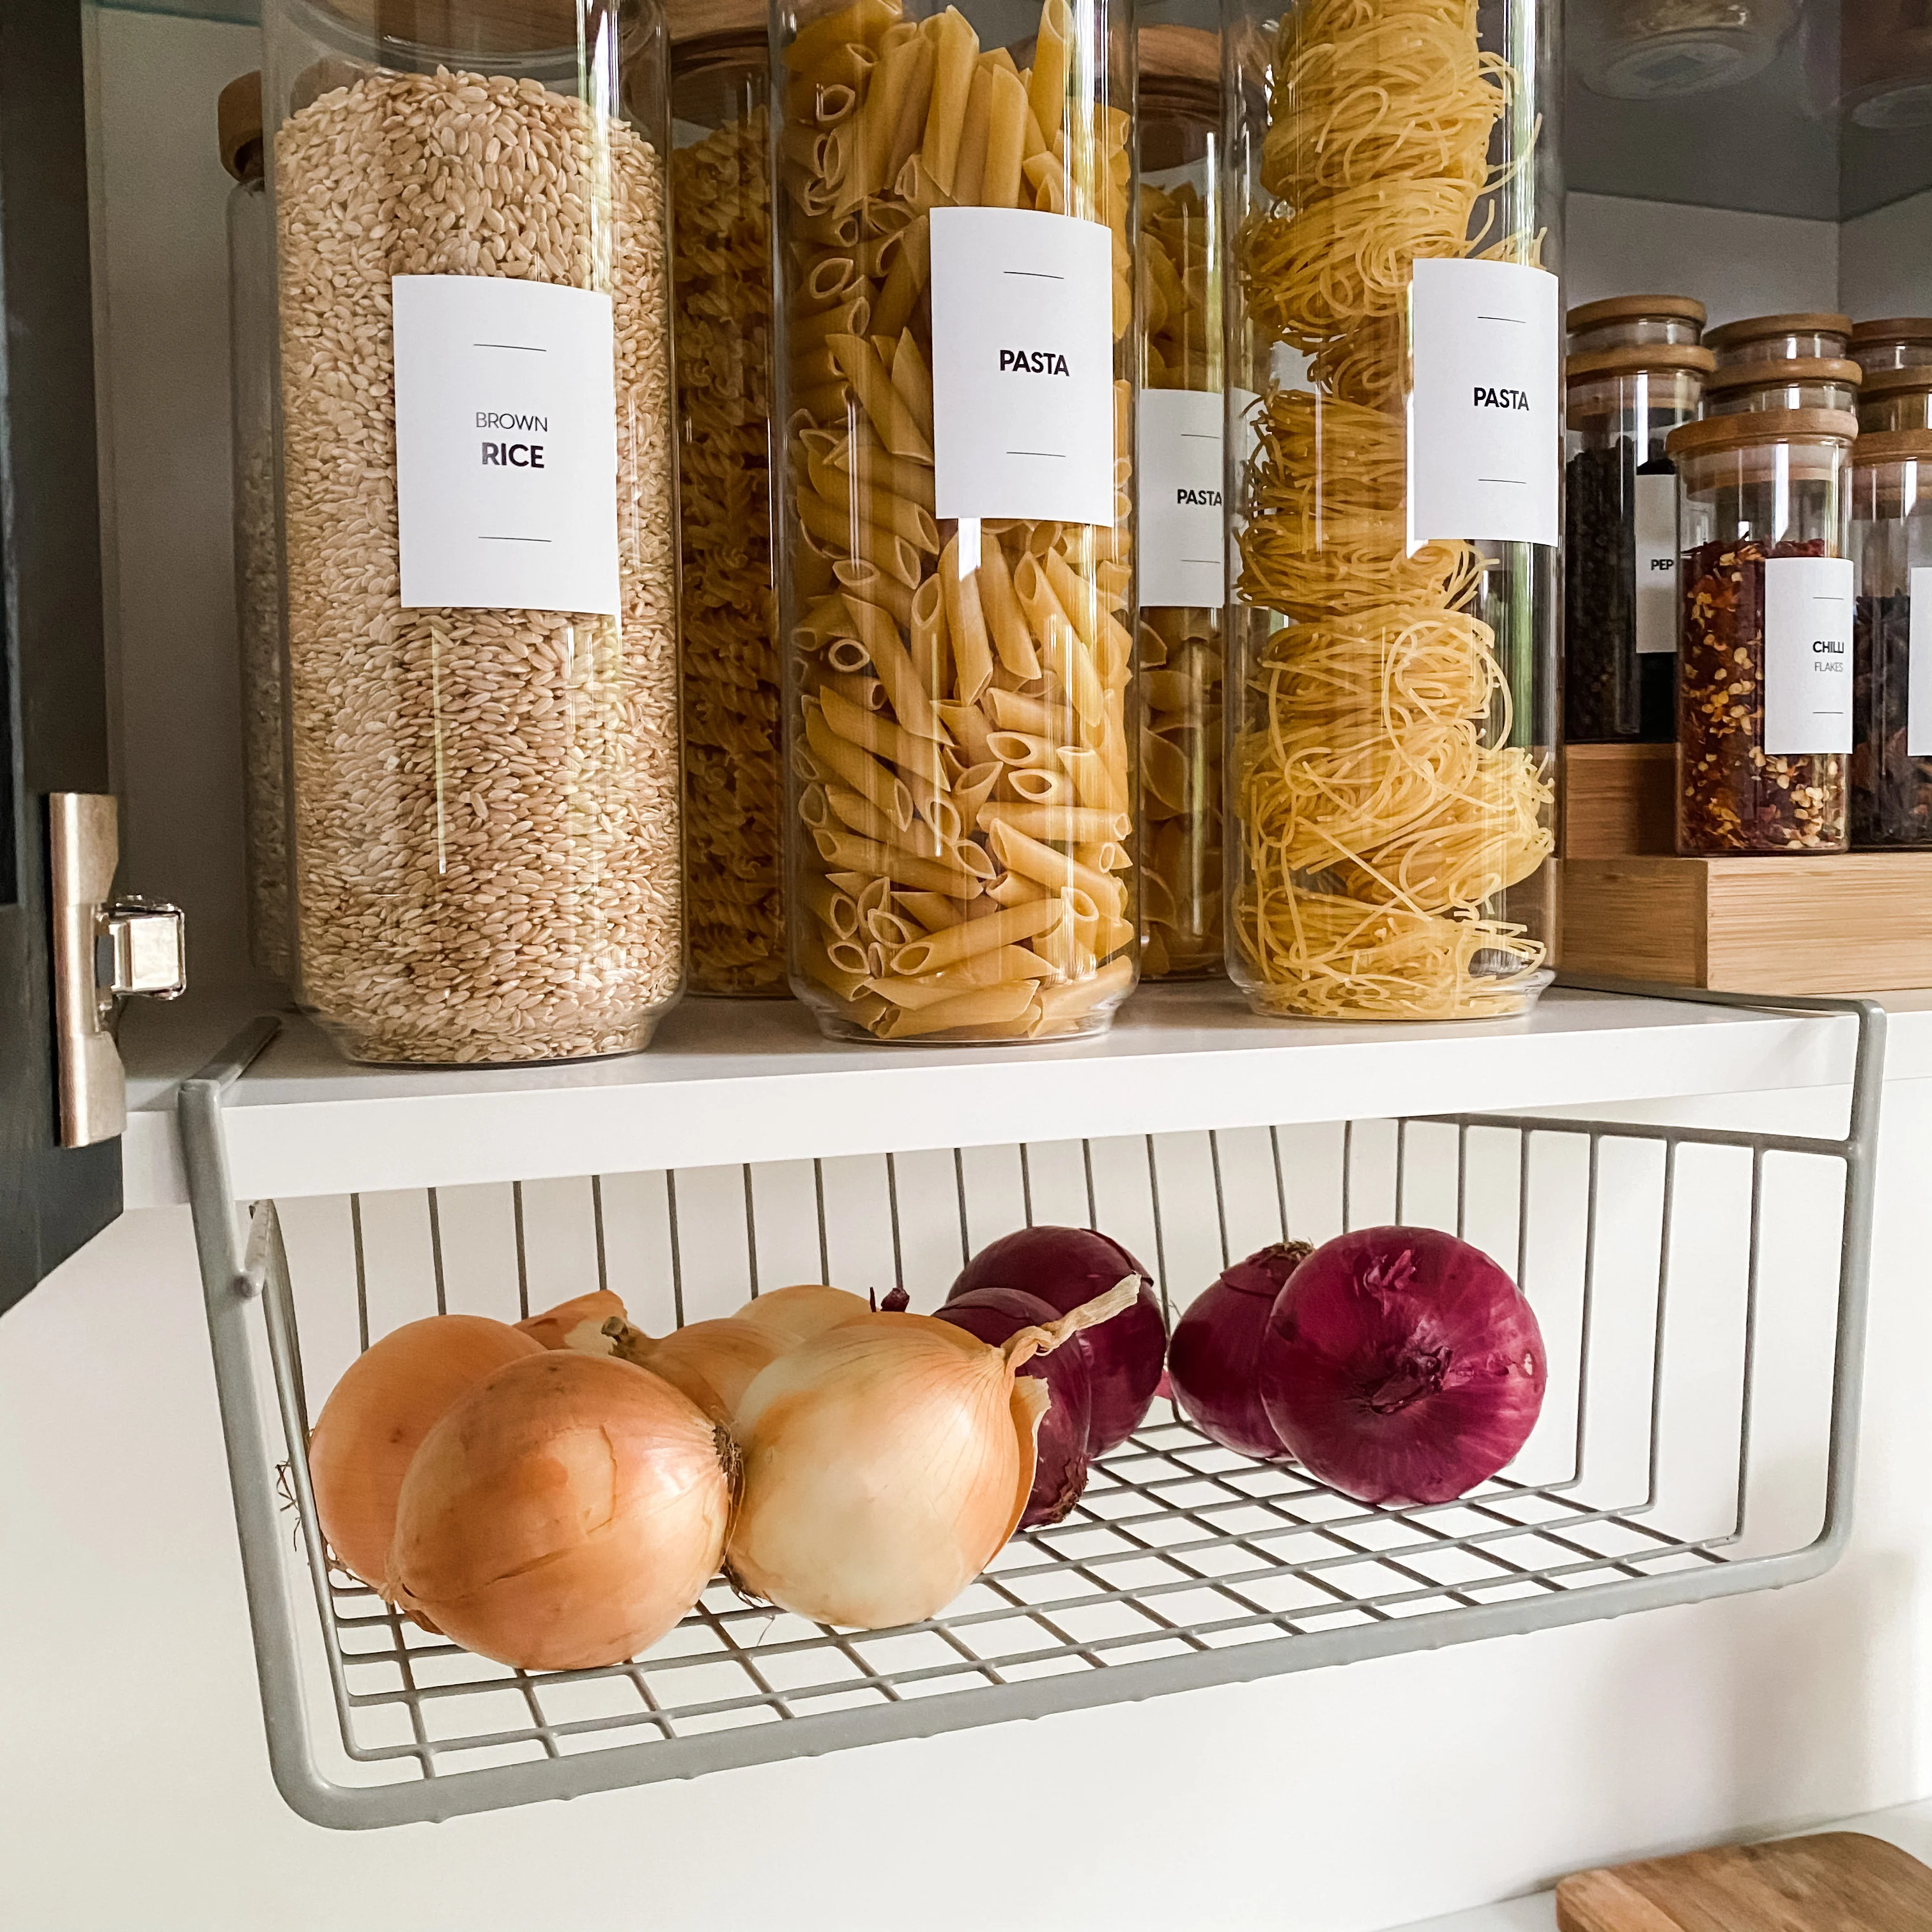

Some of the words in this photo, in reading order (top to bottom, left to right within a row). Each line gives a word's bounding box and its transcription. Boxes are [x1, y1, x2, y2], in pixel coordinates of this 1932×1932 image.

[1000, 349, 1070, 378] PASTA
[1474, 387, 1529, 411] PASTA
[475, 411, 548, 433] BROWN
[481, 442, 545, 469] RICE
[1177, 488, 1222, 507] PASTA
[1651, 558, 1675, 571] PEP
[1813, 641, 1844, 654] CHILLI
[1814, 661, 1843, 672] FLAKES
